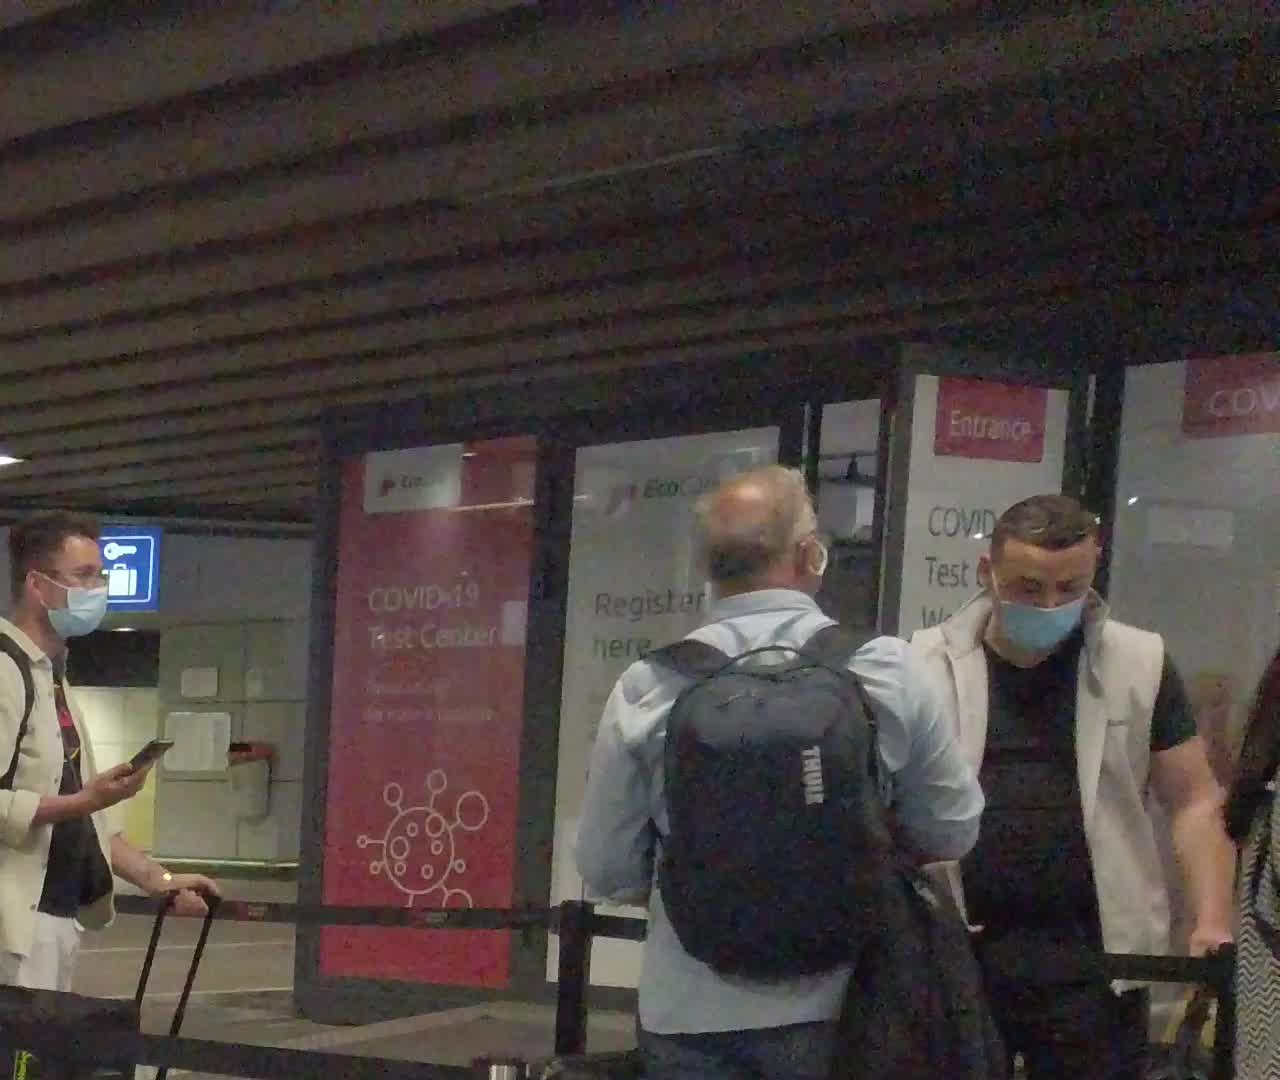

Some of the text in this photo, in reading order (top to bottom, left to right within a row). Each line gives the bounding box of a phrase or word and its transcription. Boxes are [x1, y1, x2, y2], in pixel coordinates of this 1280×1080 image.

[1208, 387, 1280, 419] COV
[950, 409, 1032, 441] Entrance
[924, 555, 969, 588] Test
[368, 583, 480, 612] COVID-19
[595, 587, 706, 622] Register
[367, 627, 418, 650] Test
[593, 637, 652, 661] here
